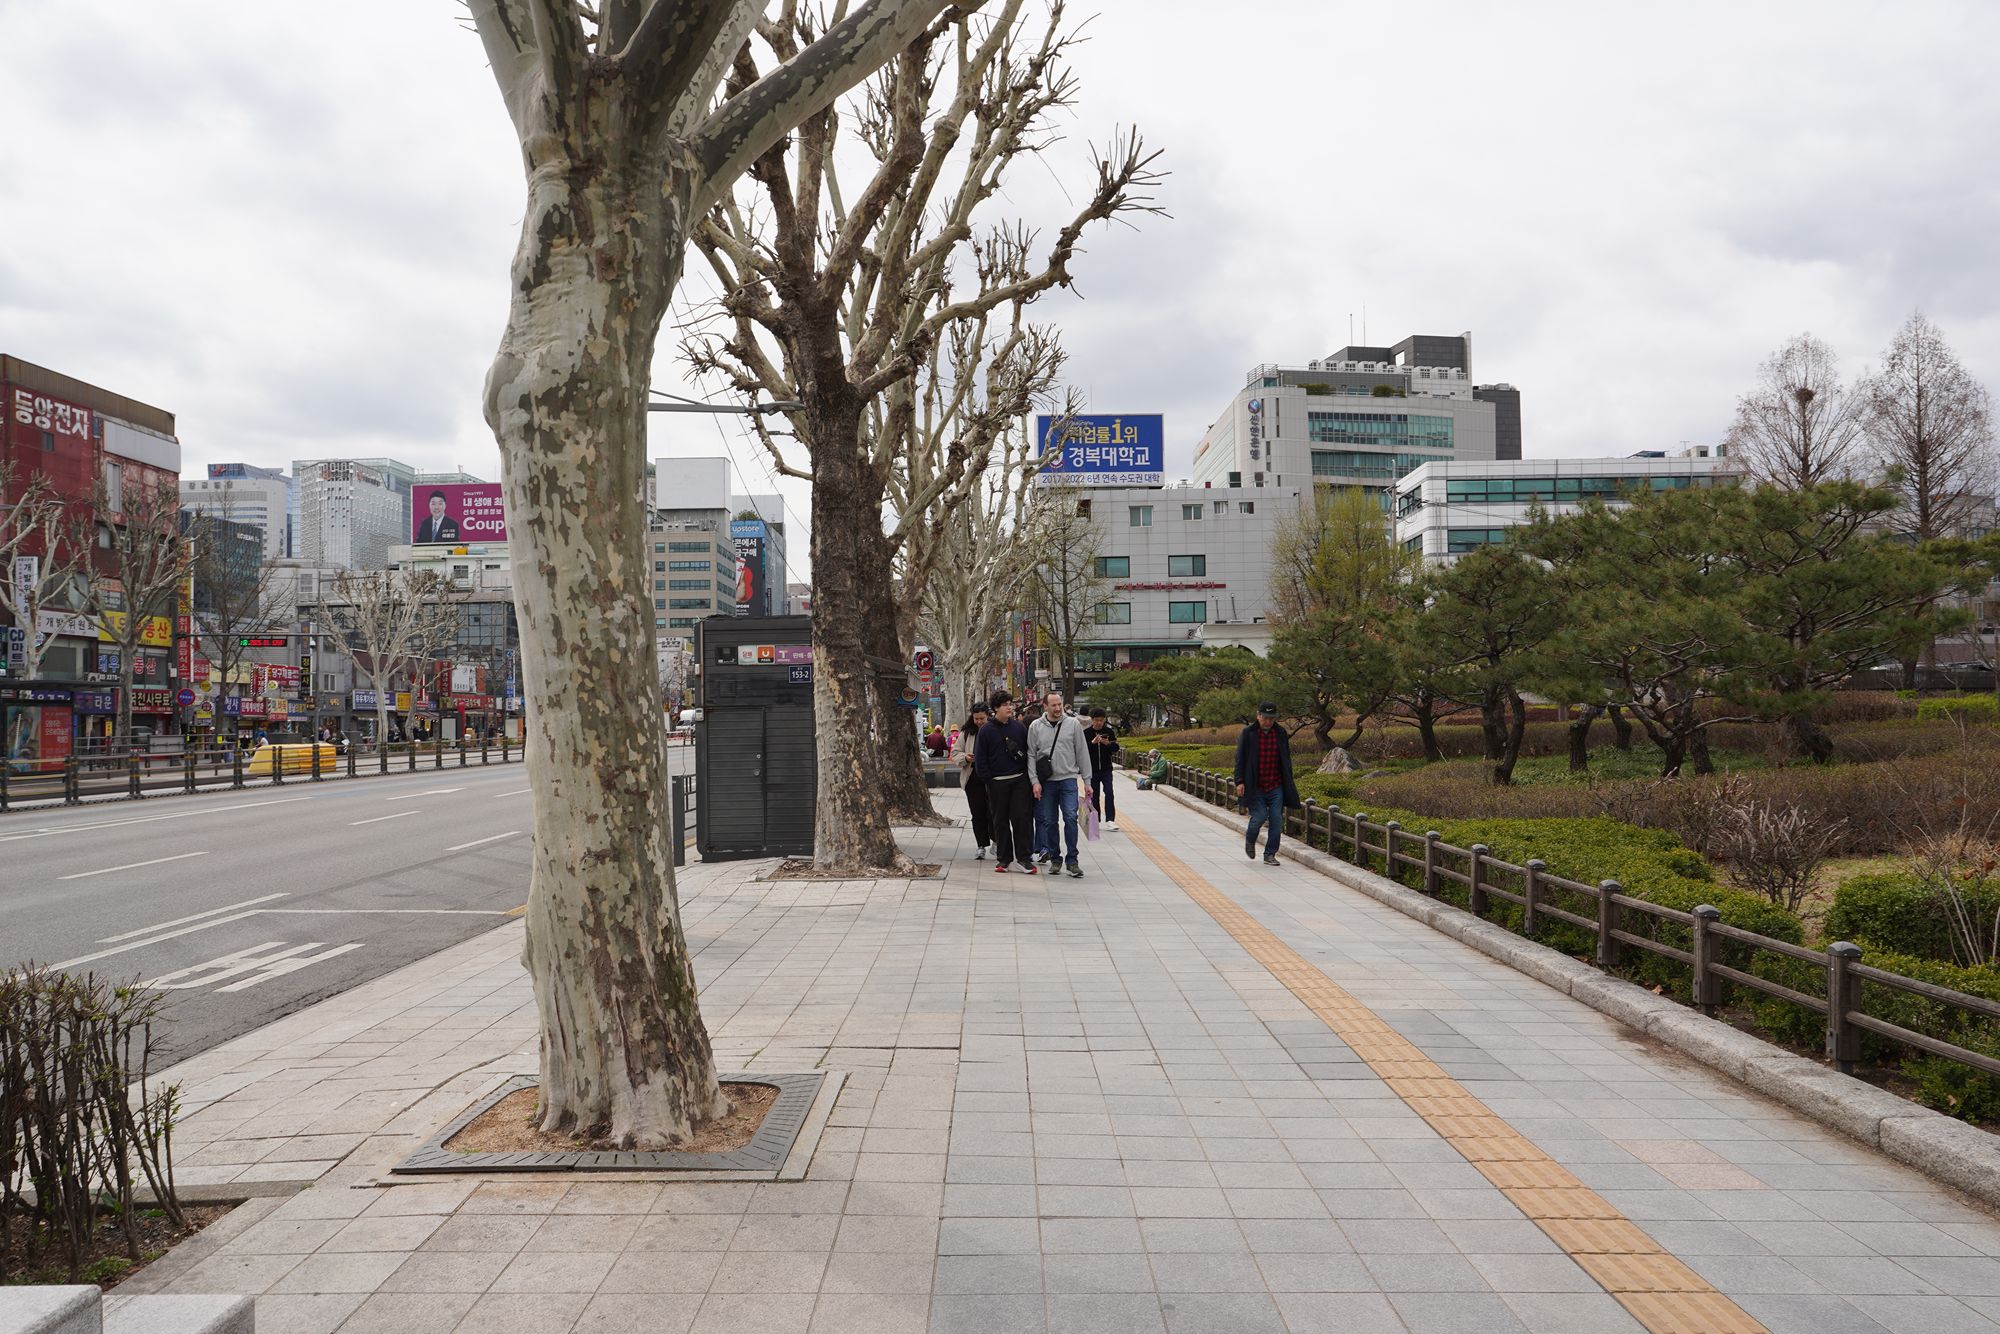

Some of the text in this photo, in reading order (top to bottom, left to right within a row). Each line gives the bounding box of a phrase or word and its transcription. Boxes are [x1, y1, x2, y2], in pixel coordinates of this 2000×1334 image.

[1068, 446, 1151, 468] 경복대학교
[1087, 474, 1100, 484] 6년
[1102, 473, 1118, 484] 연속
[1119, 473, 1143, 484] 수도권
[1144, 473, 1160, 484] 대학
[463, 497, 473, 507] 내
[473, 497, 492, 507] 생애
[9, 629, 25, 641] CD
[791, 670, 809, 679] 153-2
